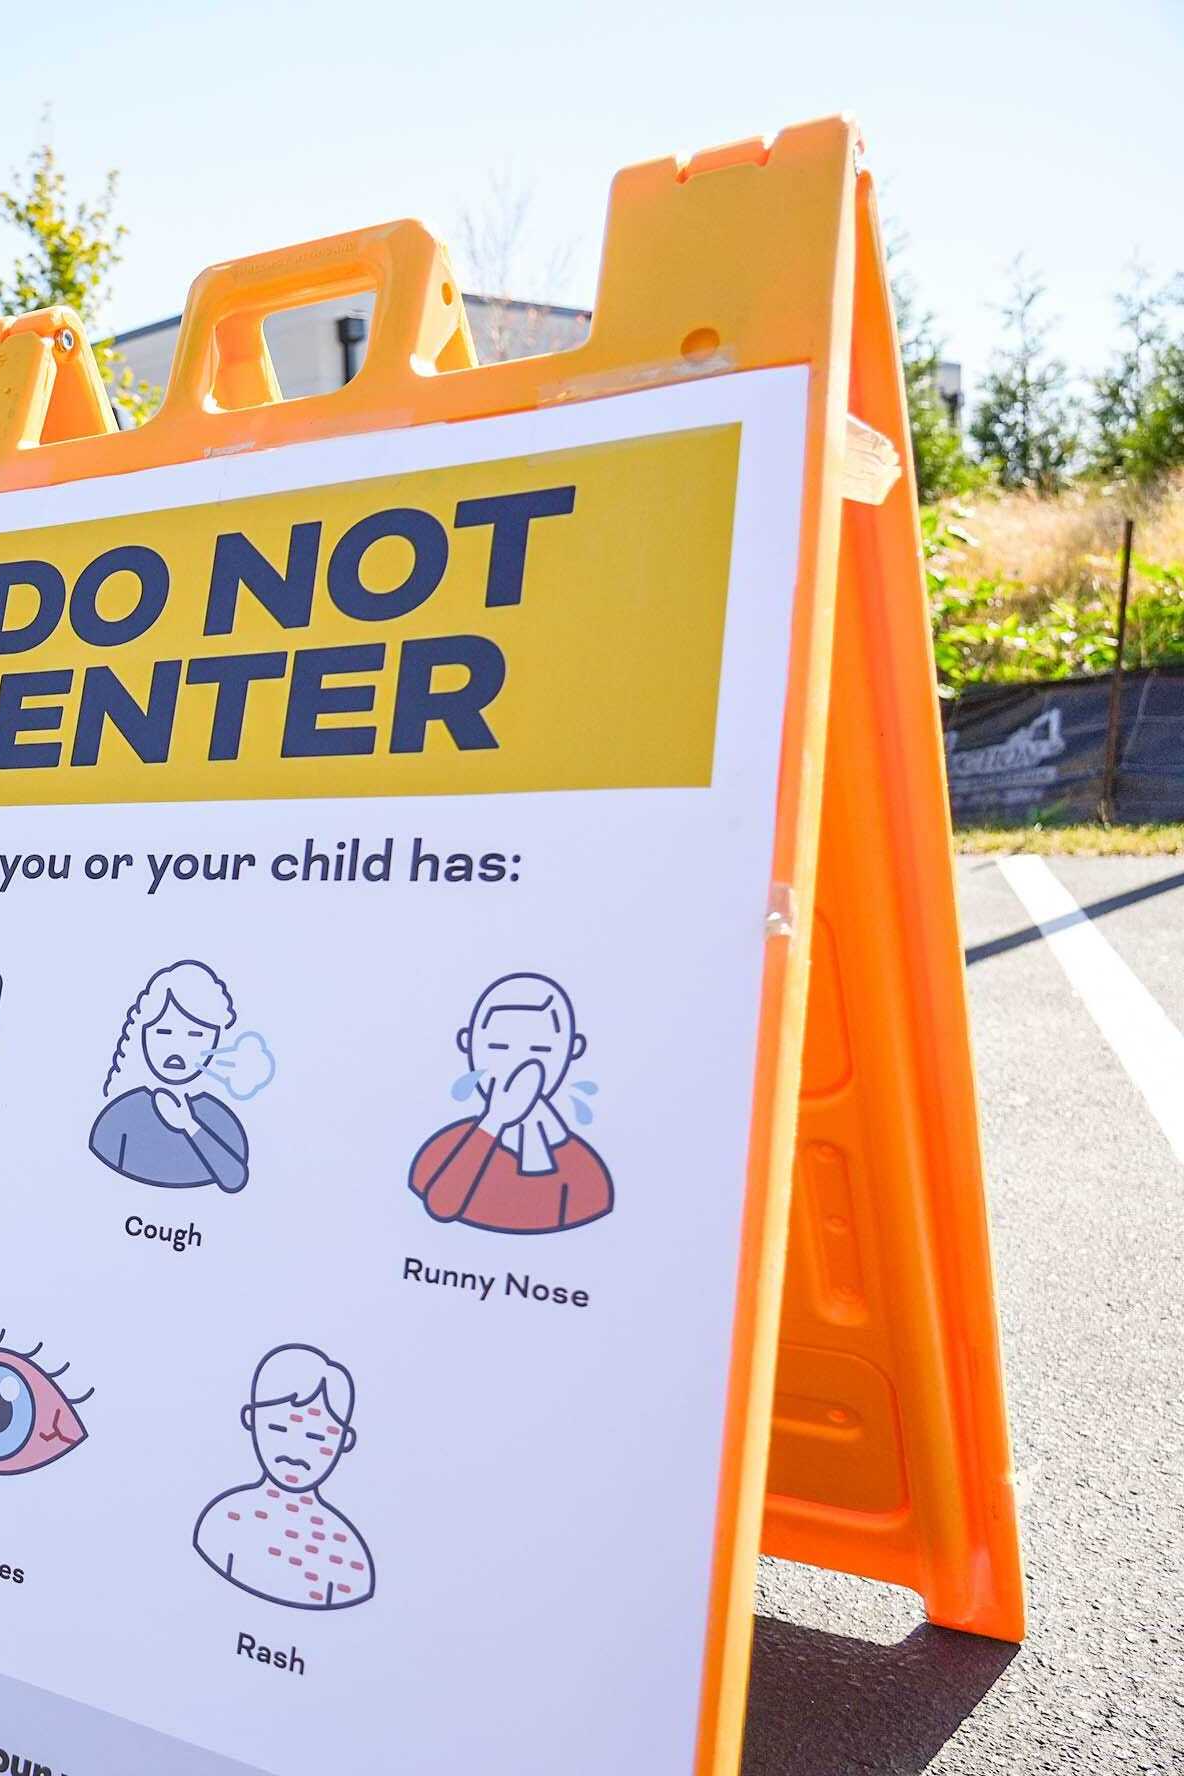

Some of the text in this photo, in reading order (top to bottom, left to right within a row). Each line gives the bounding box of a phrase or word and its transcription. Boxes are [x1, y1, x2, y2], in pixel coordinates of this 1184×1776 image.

[202, 484, 577, 637] NOT
[84, 854, 134, 880] or
[146, 853, 256, 895] your
[271, 837, 394, 882] child
[409, 837, 521, 883] has:
[124, 1215, 202, 1252] Cough
[403, 1257, 589, 1308] Runny Nose
[236, 1631, 305, 1676] Rash
